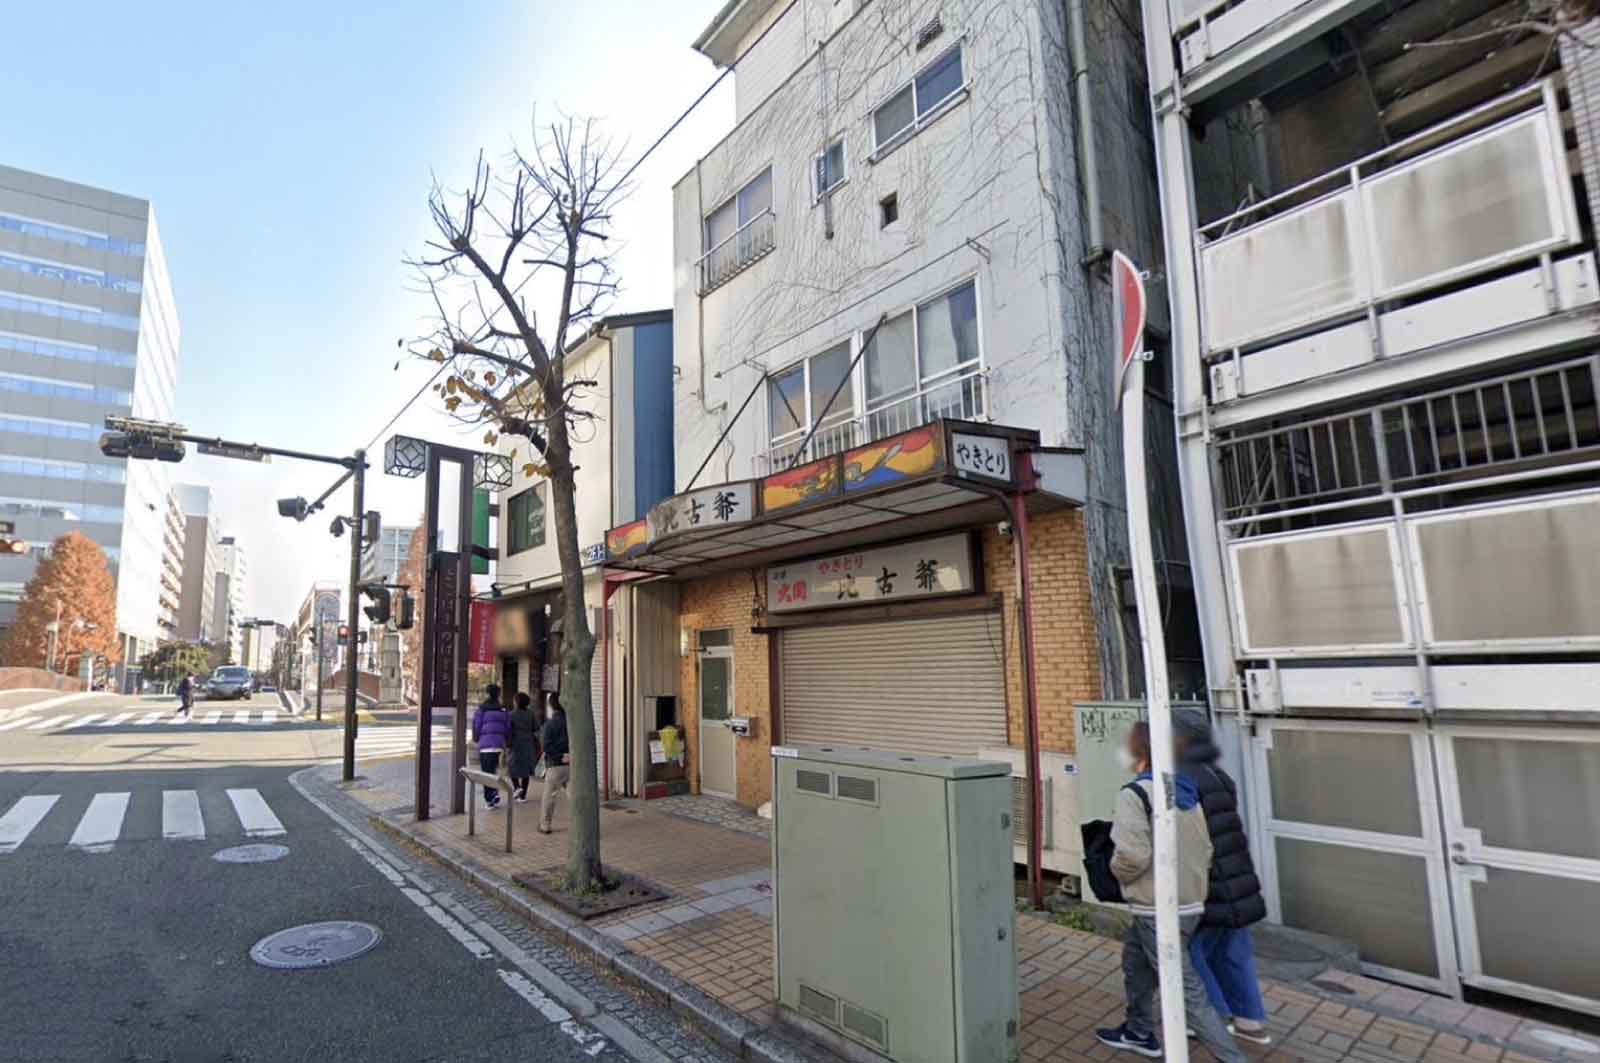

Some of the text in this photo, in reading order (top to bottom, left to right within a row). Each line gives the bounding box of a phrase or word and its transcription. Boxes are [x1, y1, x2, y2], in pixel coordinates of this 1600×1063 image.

[956, 443, 1006, 475] やきとり
[817, 554, 865, 575] やきとり
